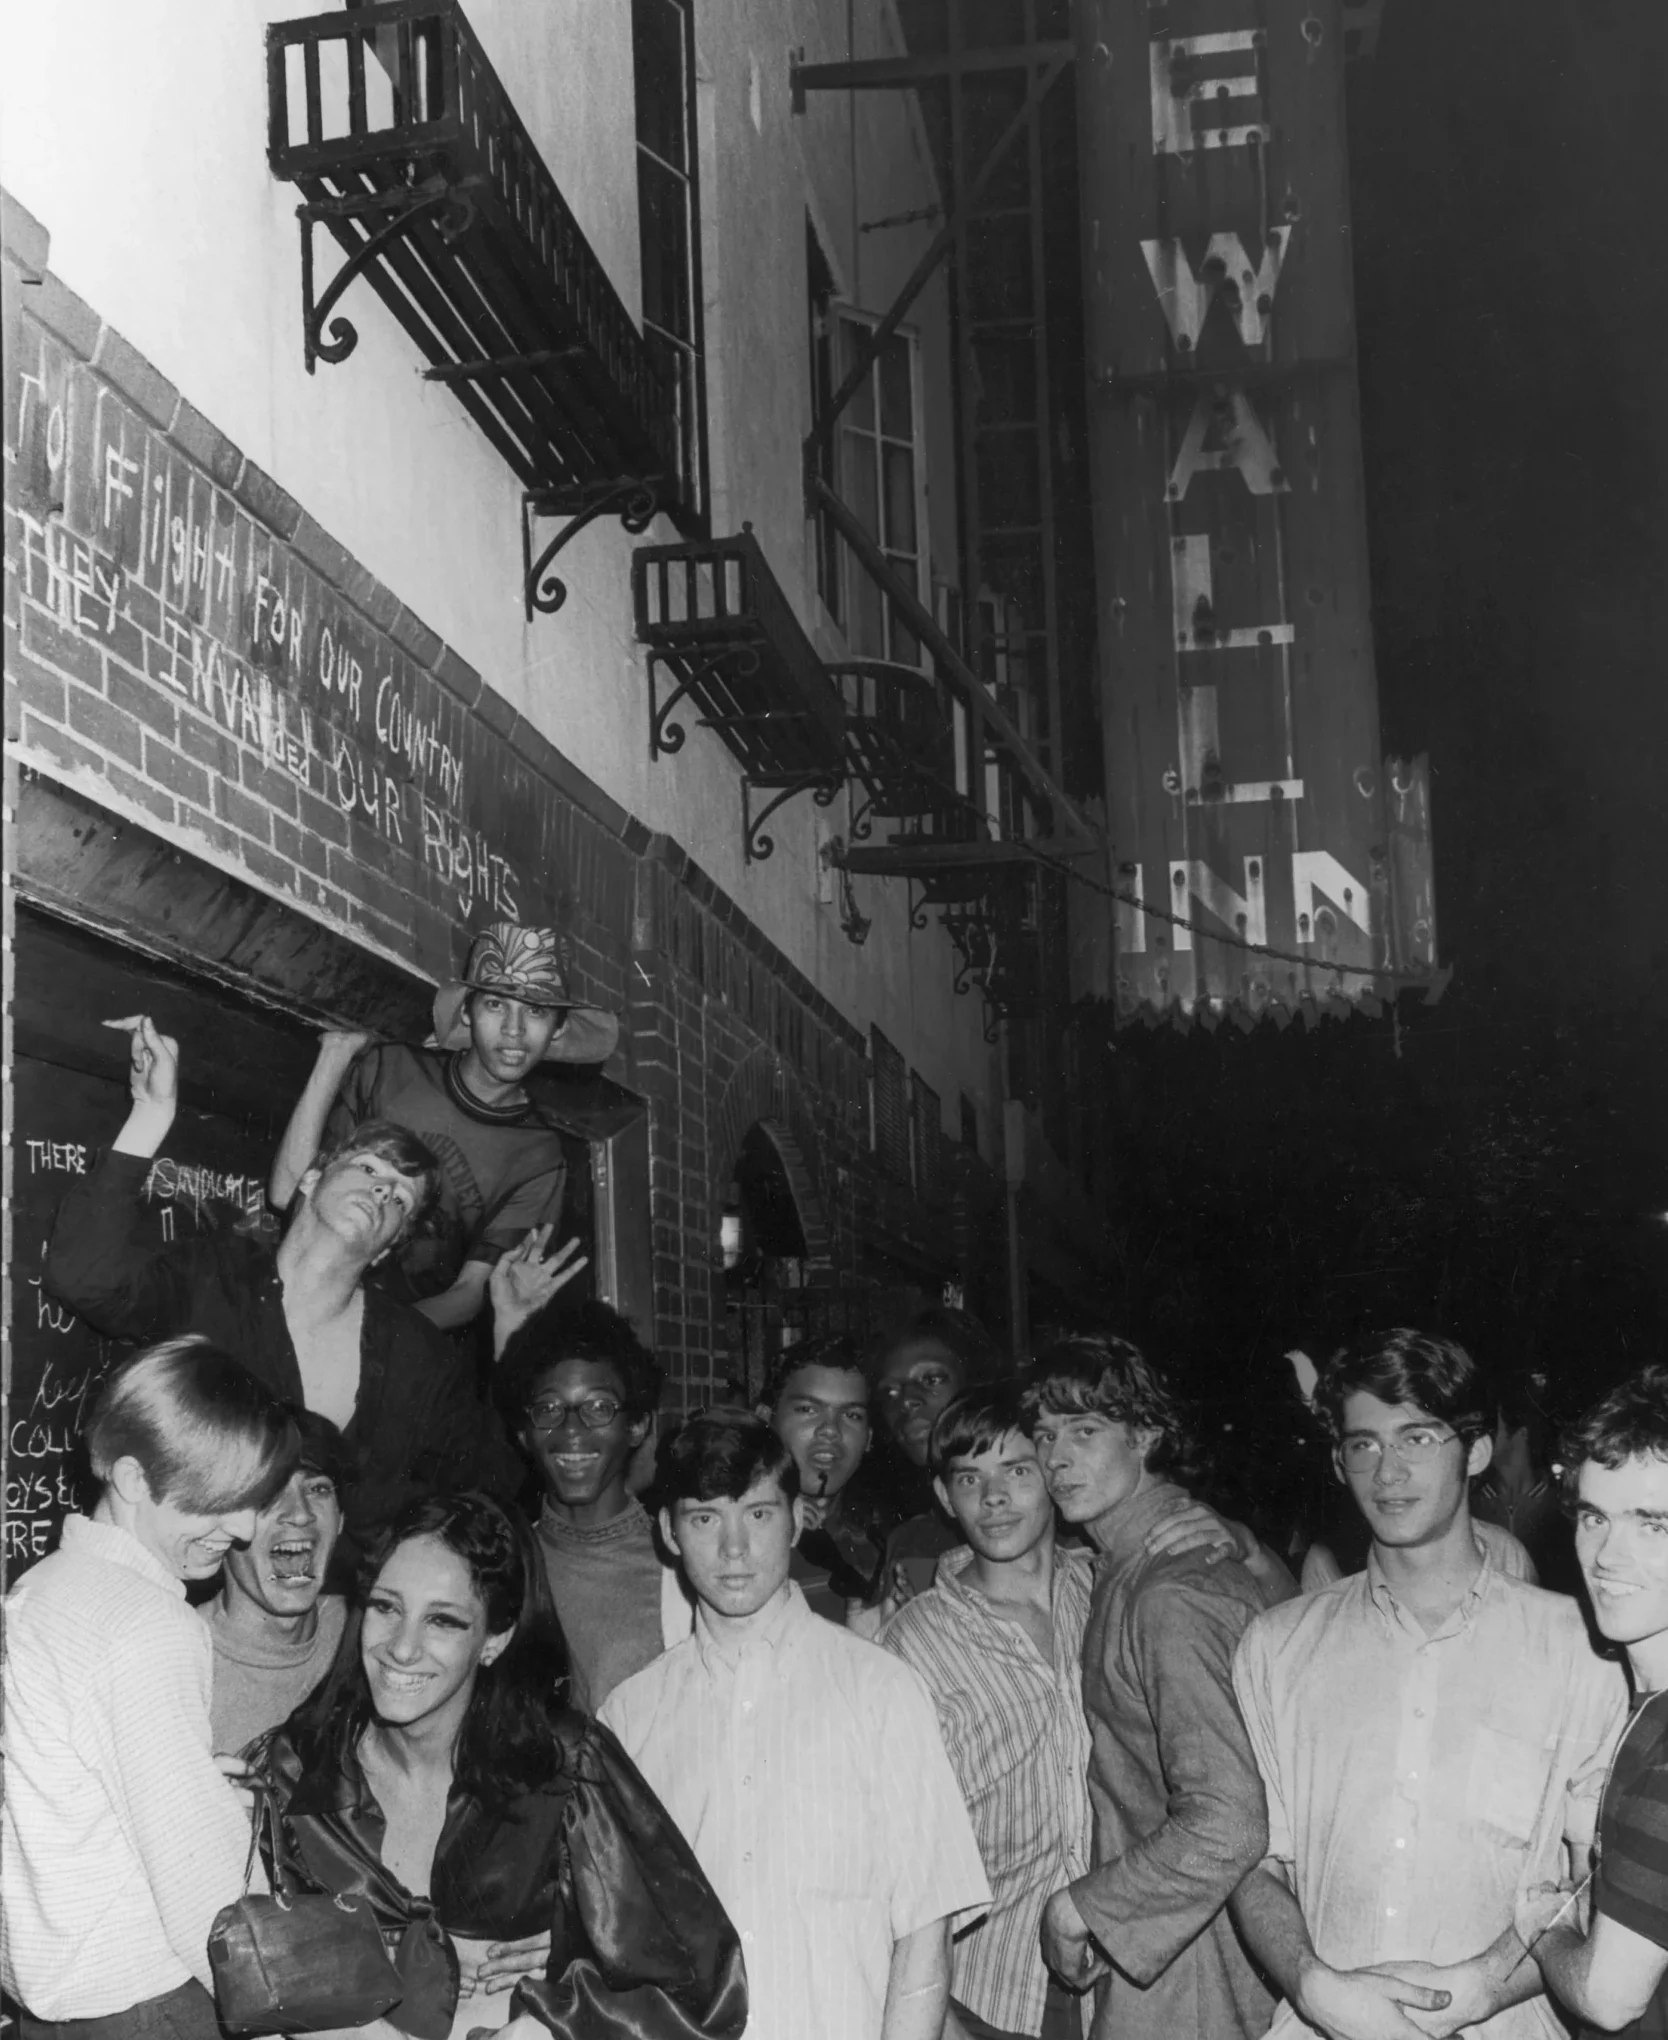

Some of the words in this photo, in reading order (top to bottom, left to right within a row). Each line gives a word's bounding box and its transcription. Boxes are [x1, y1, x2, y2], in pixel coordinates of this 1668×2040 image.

[1140, 0, 1306, 806] EWALL
[19, 373, 65, 473] TO
[254, 575, 302, 672] FOR
[320, 627, 363, 722] OUR
[17, 508, 120, 634] THEY
[337, 739, 403, 844] OUR
[1118, 850, 1371, 953] INN
[25, 1139, 88, 1175] THERE
[10, 1419, 75, 1458] COLL
[5, 1471, 54, 1511] OYS
[1, 1519, 53, 1559] ERE
